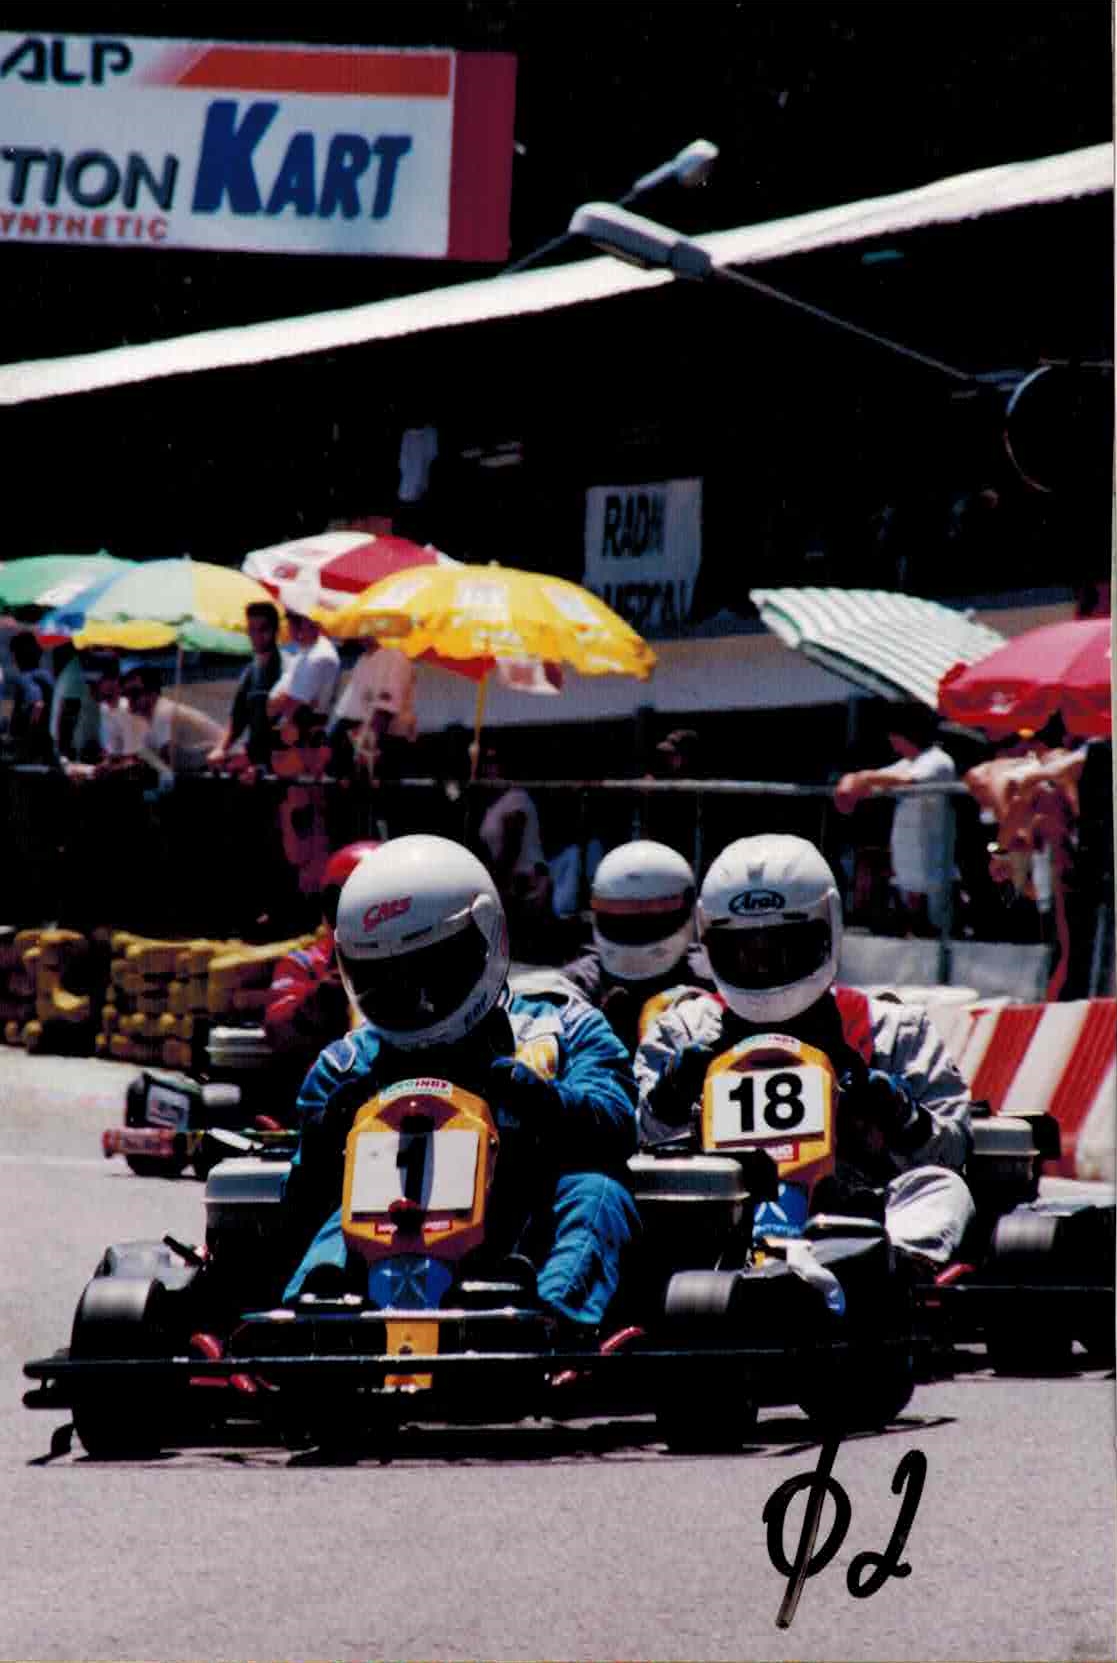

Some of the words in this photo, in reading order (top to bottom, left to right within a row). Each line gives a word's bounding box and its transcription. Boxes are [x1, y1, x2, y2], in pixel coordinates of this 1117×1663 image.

[0, 37, 133, 85] ALP
[1, 147, 180, 211] TION
[192, 101, 413, 219] KART
[729, 1072, 806, 1132] 18
[396, 1134, 428, 1208] 1
